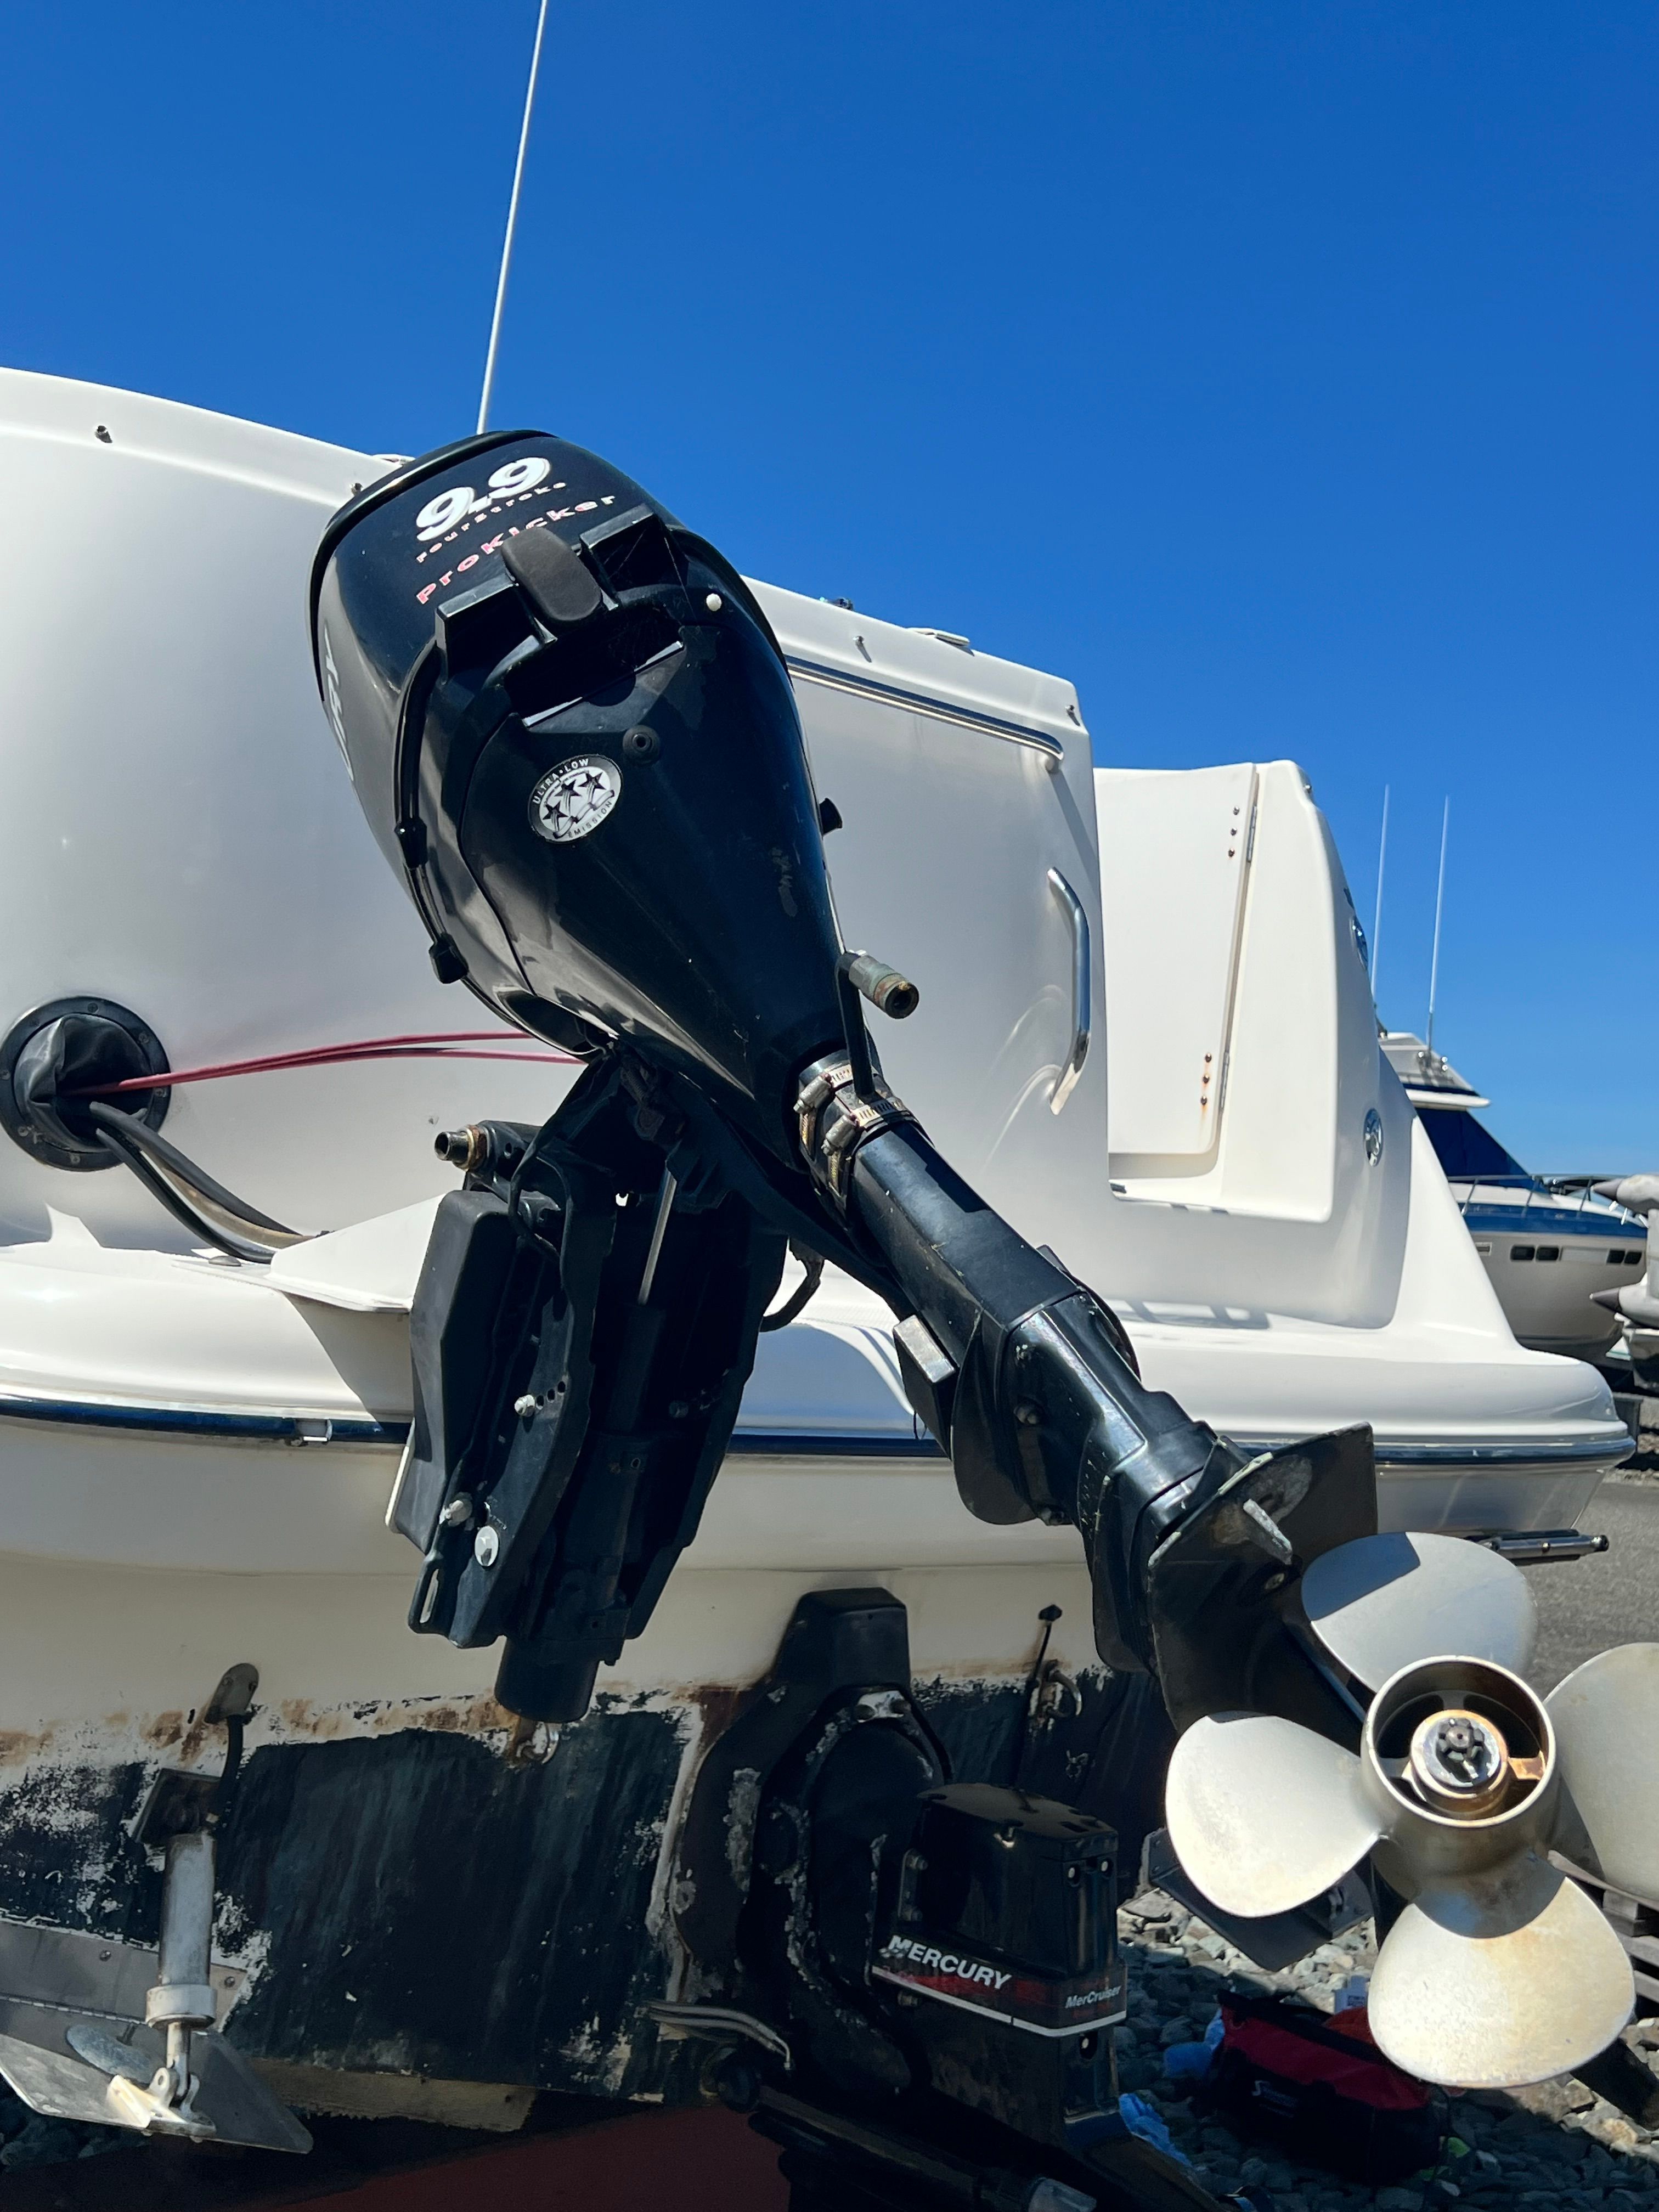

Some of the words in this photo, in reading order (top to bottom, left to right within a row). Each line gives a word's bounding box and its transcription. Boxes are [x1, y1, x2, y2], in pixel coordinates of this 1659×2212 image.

[416, 456, 552, 541] 9.9
[887, 1935, 1012, 1990] MERCURY
[1065, 1985, 1122, 2008] MerCruiser
